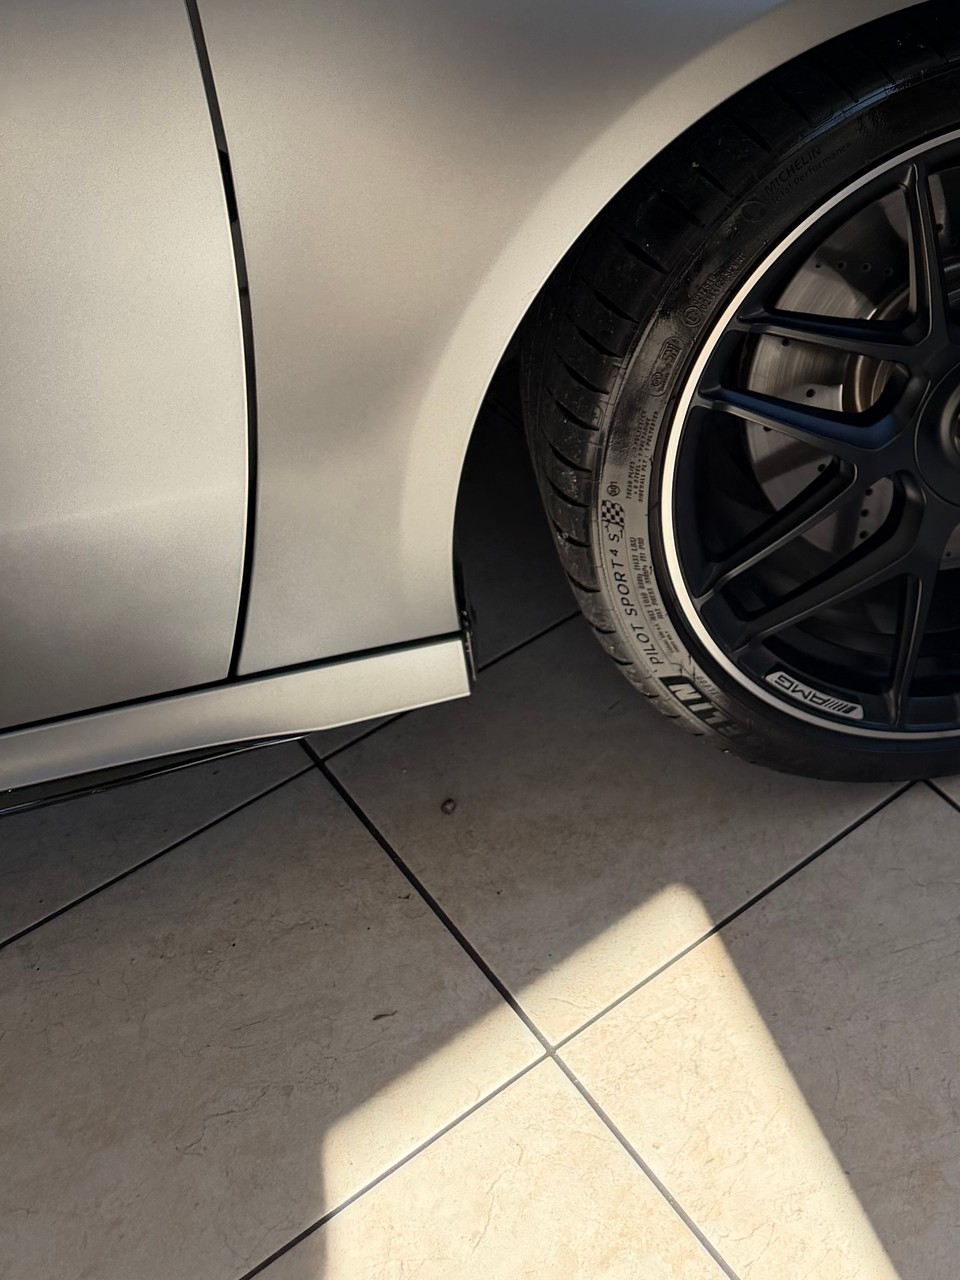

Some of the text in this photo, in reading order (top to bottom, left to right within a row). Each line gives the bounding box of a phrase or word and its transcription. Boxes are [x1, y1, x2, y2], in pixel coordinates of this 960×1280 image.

[763, 144, 823, 197] MICHELIN
[611, 559, 638, 616] SPORT
[631, 623, 664, 665] PILOT
[774, 674, 832, 706] AMG
